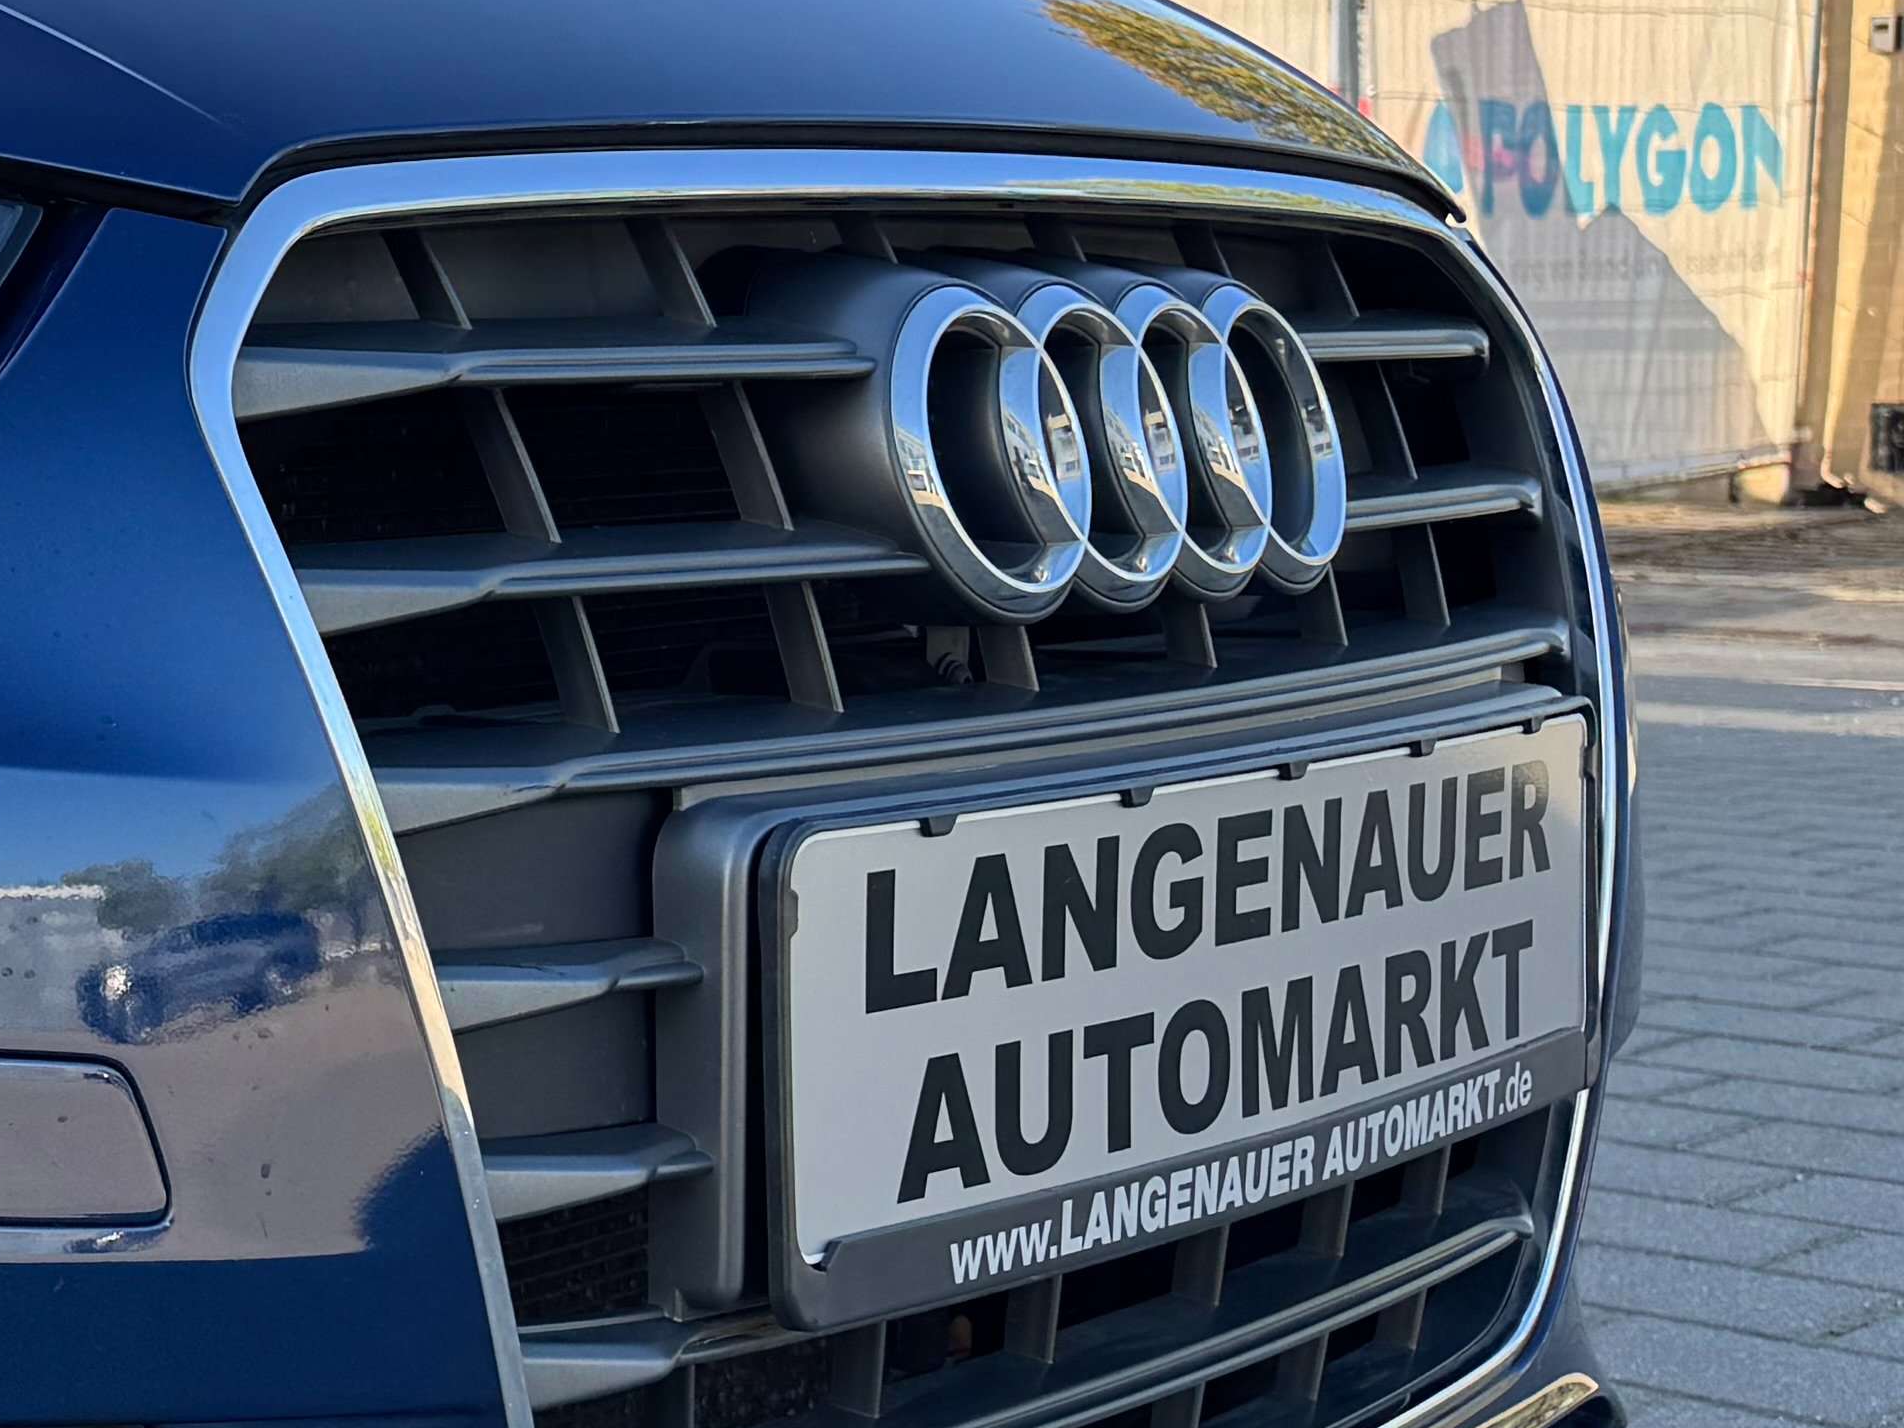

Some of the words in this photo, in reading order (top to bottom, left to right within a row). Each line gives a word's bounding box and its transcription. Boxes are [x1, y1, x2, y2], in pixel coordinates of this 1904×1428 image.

[1479, 99, 1784, 218] POLYGON
[864, 759, 1552, 1015] LANGENAUER
[896, 918, 1534, 1205] AUTOMARKT
[1322, 1061, 1534, 1184] AUTOMARKT.de
